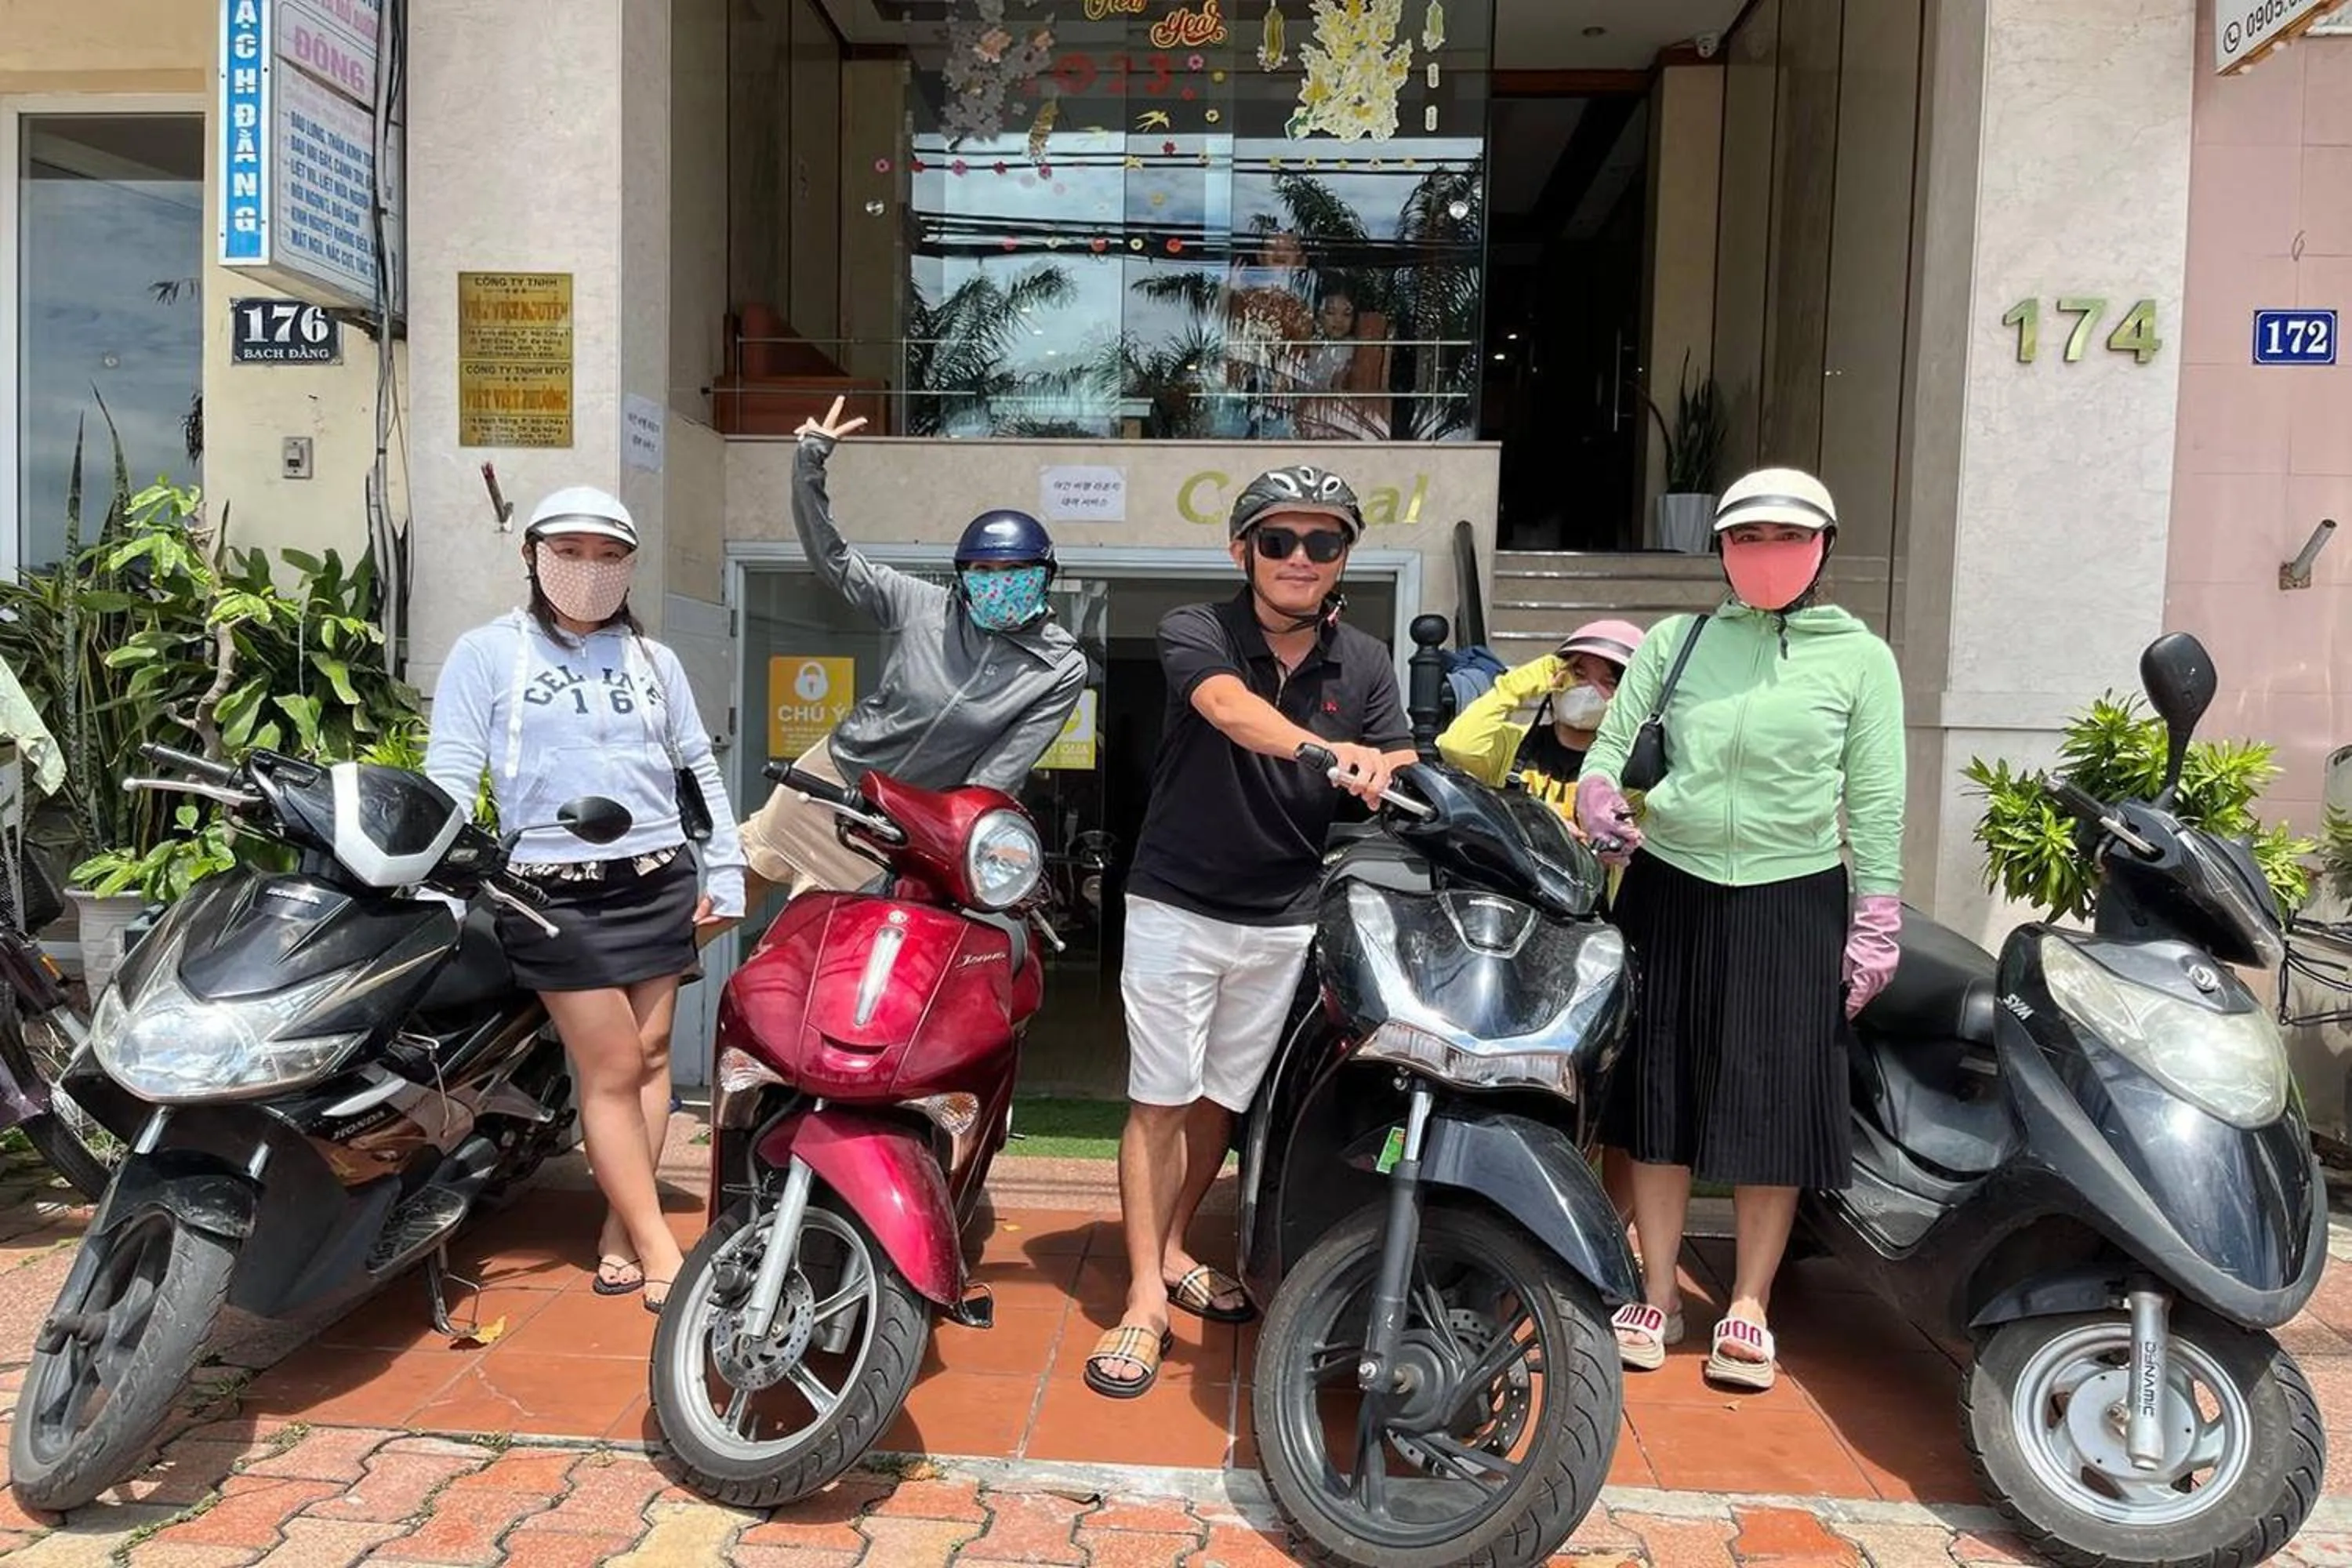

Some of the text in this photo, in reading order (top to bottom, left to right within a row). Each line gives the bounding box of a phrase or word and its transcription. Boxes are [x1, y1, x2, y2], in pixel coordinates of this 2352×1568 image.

[1150, 0, 1229, 49] Year
[243, 304, 329, 343] 176
[2003, 298, 2162, 364] 174
[2265, 321, 2328, 354] 172
[778, 702, 825, 722] CHÚ
